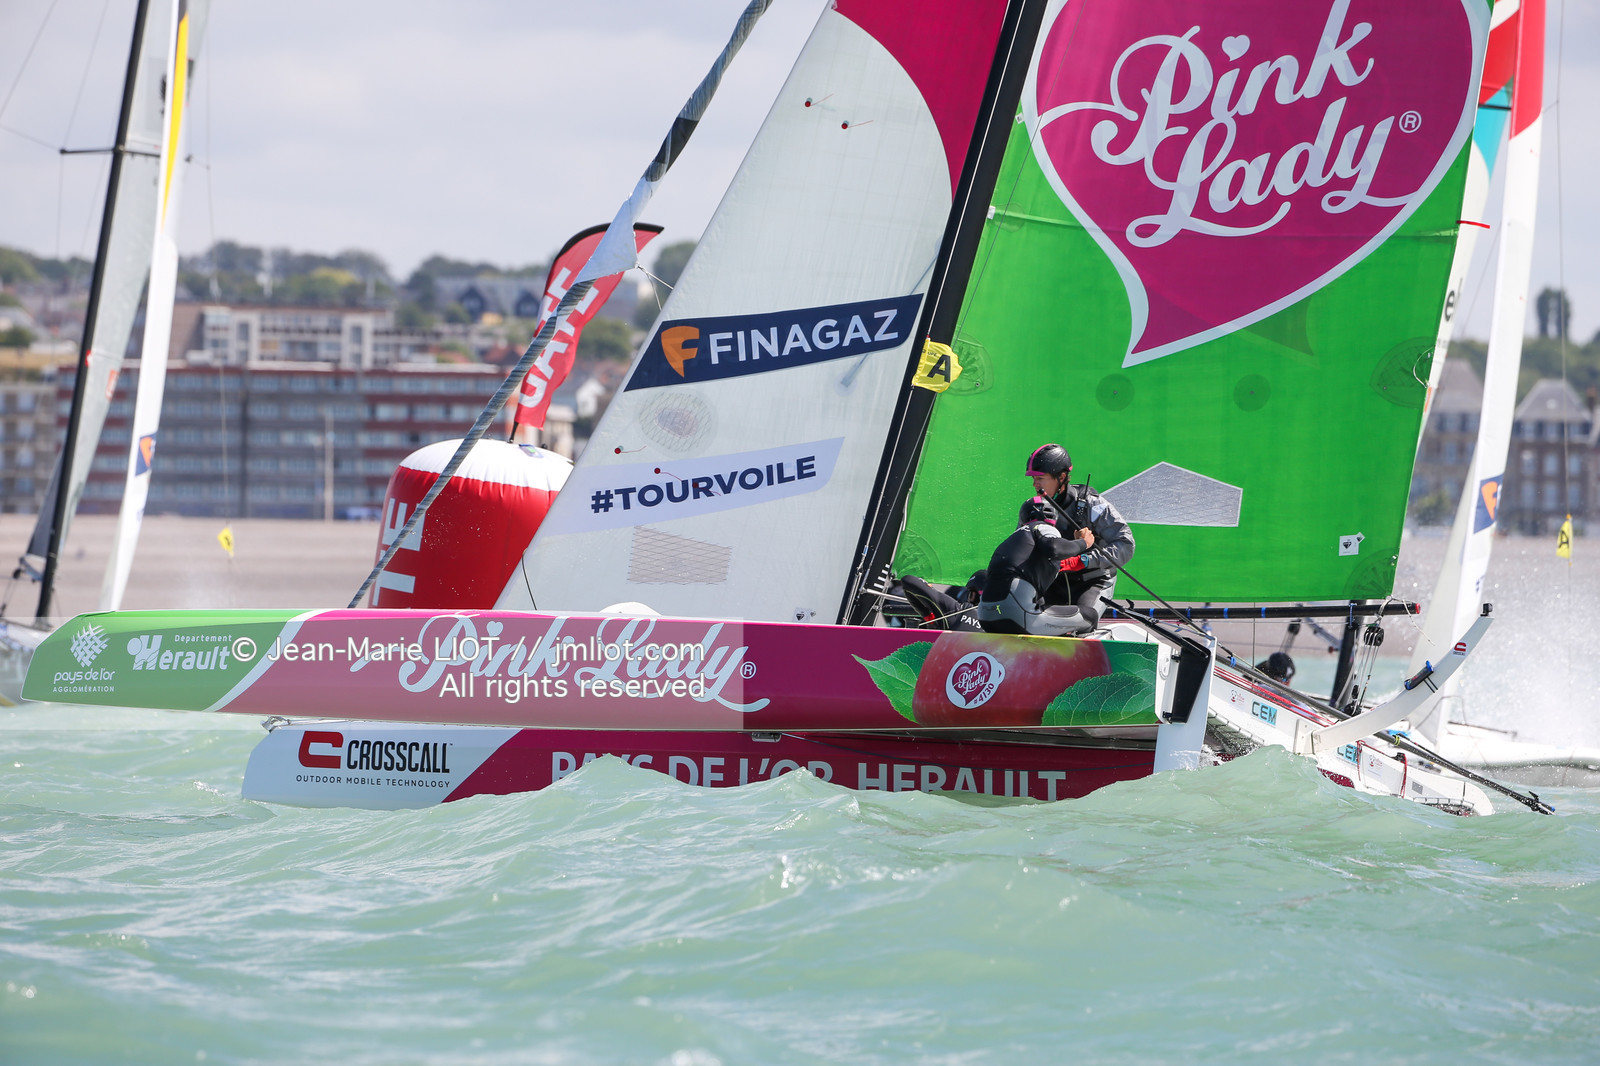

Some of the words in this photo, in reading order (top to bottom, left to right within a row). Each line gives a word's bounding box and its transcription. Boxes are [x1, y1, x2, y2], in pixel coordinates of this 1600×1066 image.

[1091, 0, 1374, 165] Pink
[709, 309, 898, 364] FINAGAZ
[927, 354, 951, 383] A
[591, 455, 816, 513] #TOURVOILE
[960, 615, 981, 628] PAYS
[375, 611, 575, 693] Pink
[53, 671, 83, 684] pays
[956, 662, 983, 689] Pink
[1252, 701, 1277, 725] CEM
[347, 740, 450, 773] CROSSCALL
[296, 775, 342, 784] OUTDOOR
[346, 777, 382, 786] MOBILE
[386, 779, 450, 788] TECHNOLOGY
